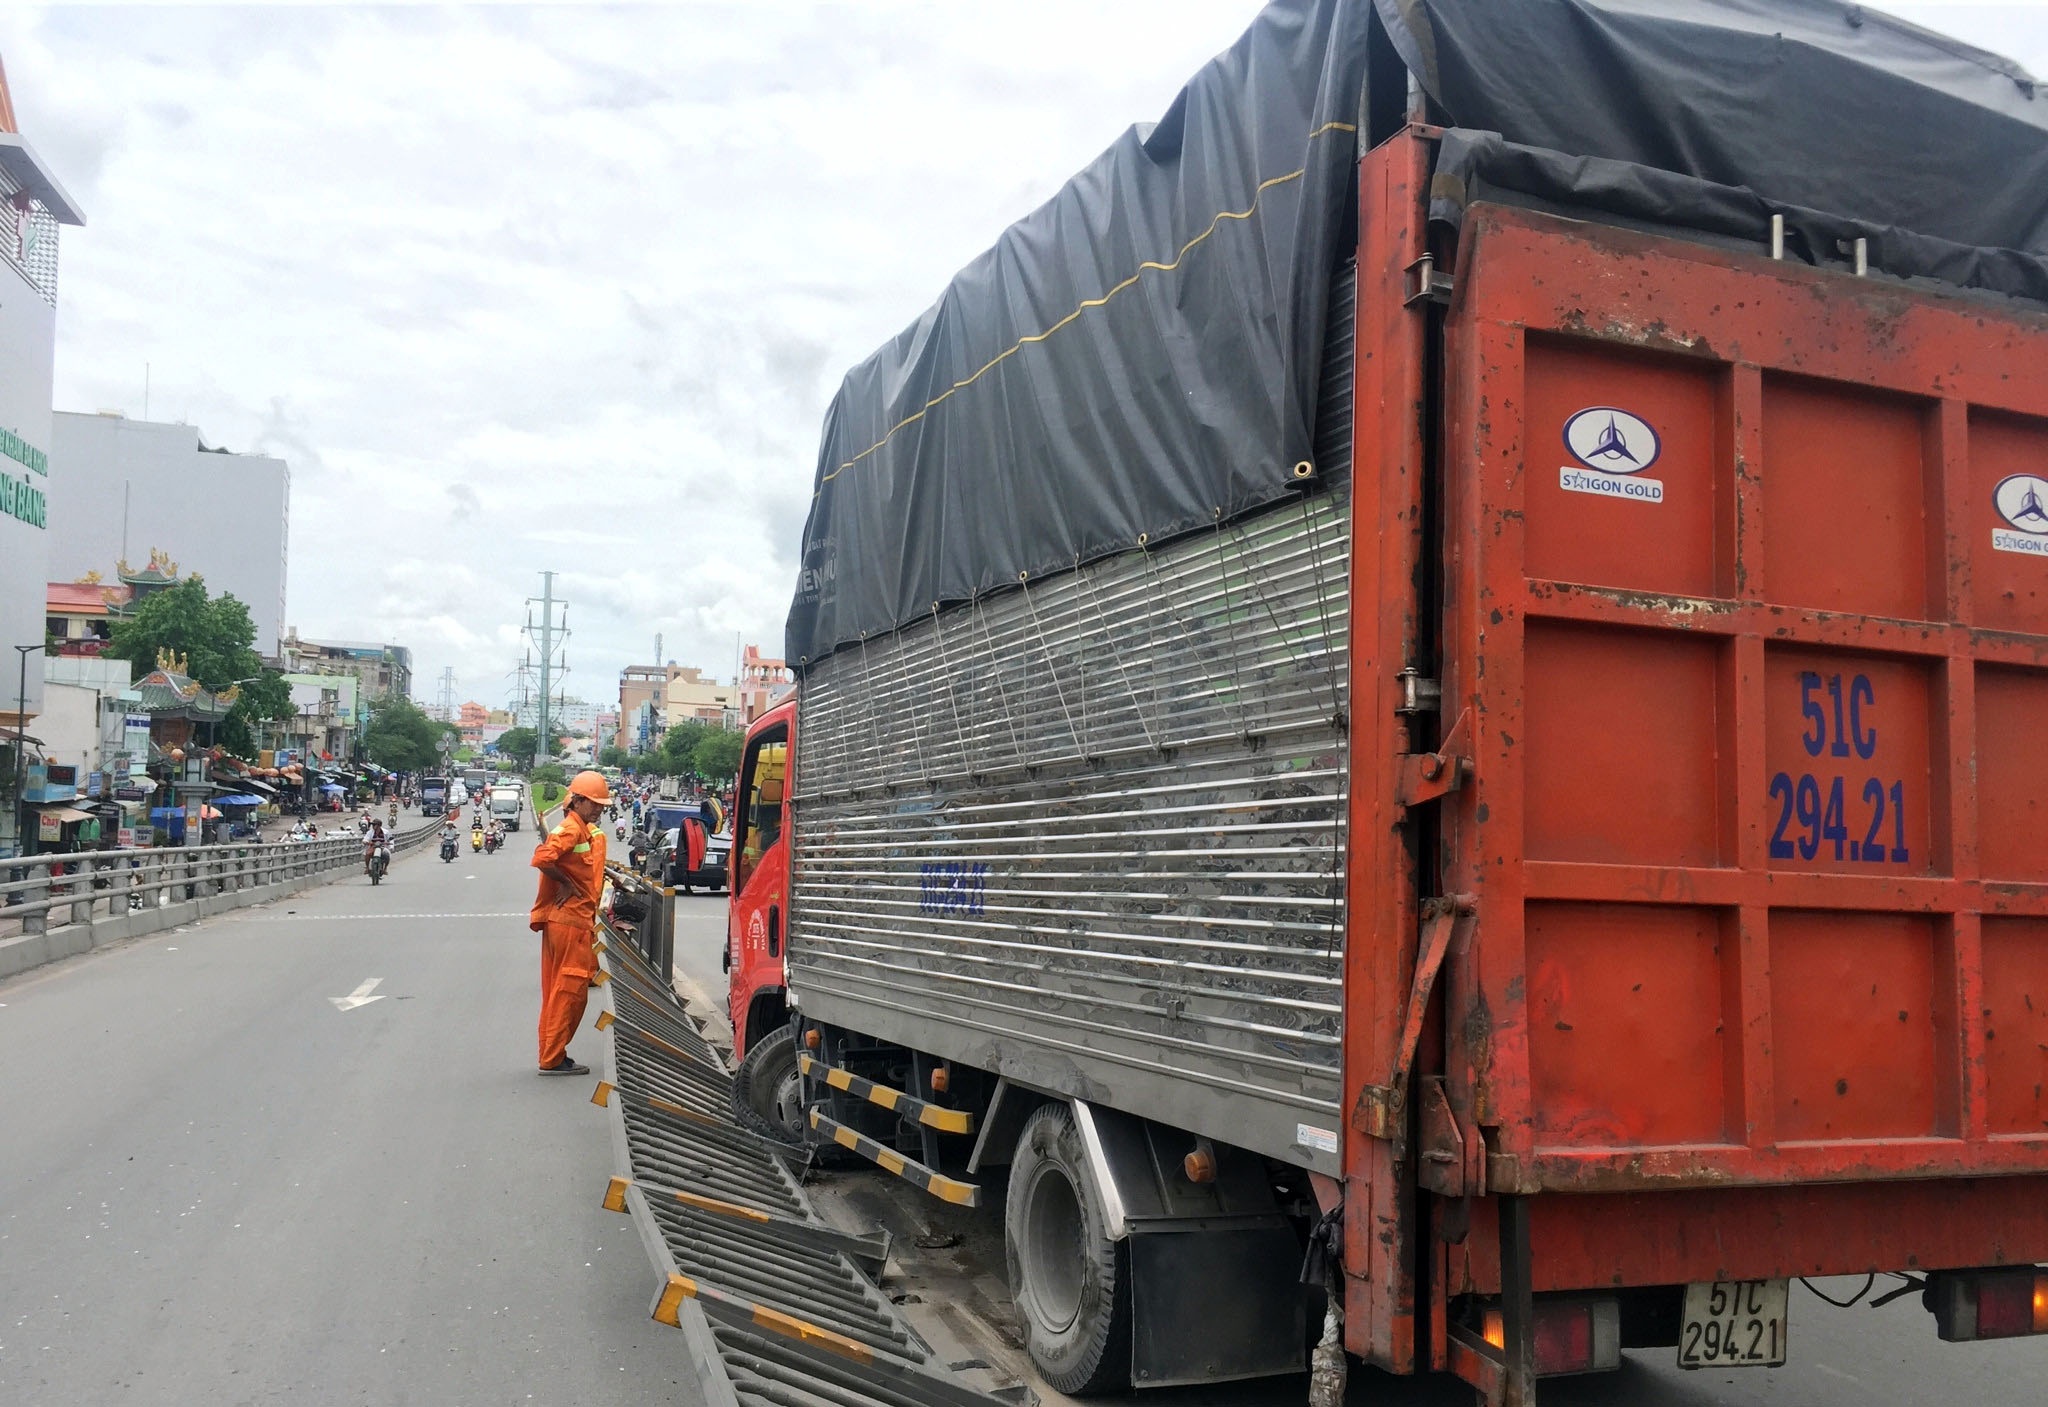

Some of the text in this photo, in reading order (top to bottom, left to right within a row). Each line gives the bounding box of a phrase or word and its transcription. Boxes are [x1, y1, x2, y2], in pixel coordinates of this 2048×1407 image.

[15, 474, 47, 529] BÀNG
[1624, 483, 1662, 499] GOLD
[1801, 671, 1876, 760] 51C
[1769, 772, 1909, 863] 294.21
[1709, 1280, 1765, 1316] 51C
[1683, 1318, 1778, 1361] 294.21
